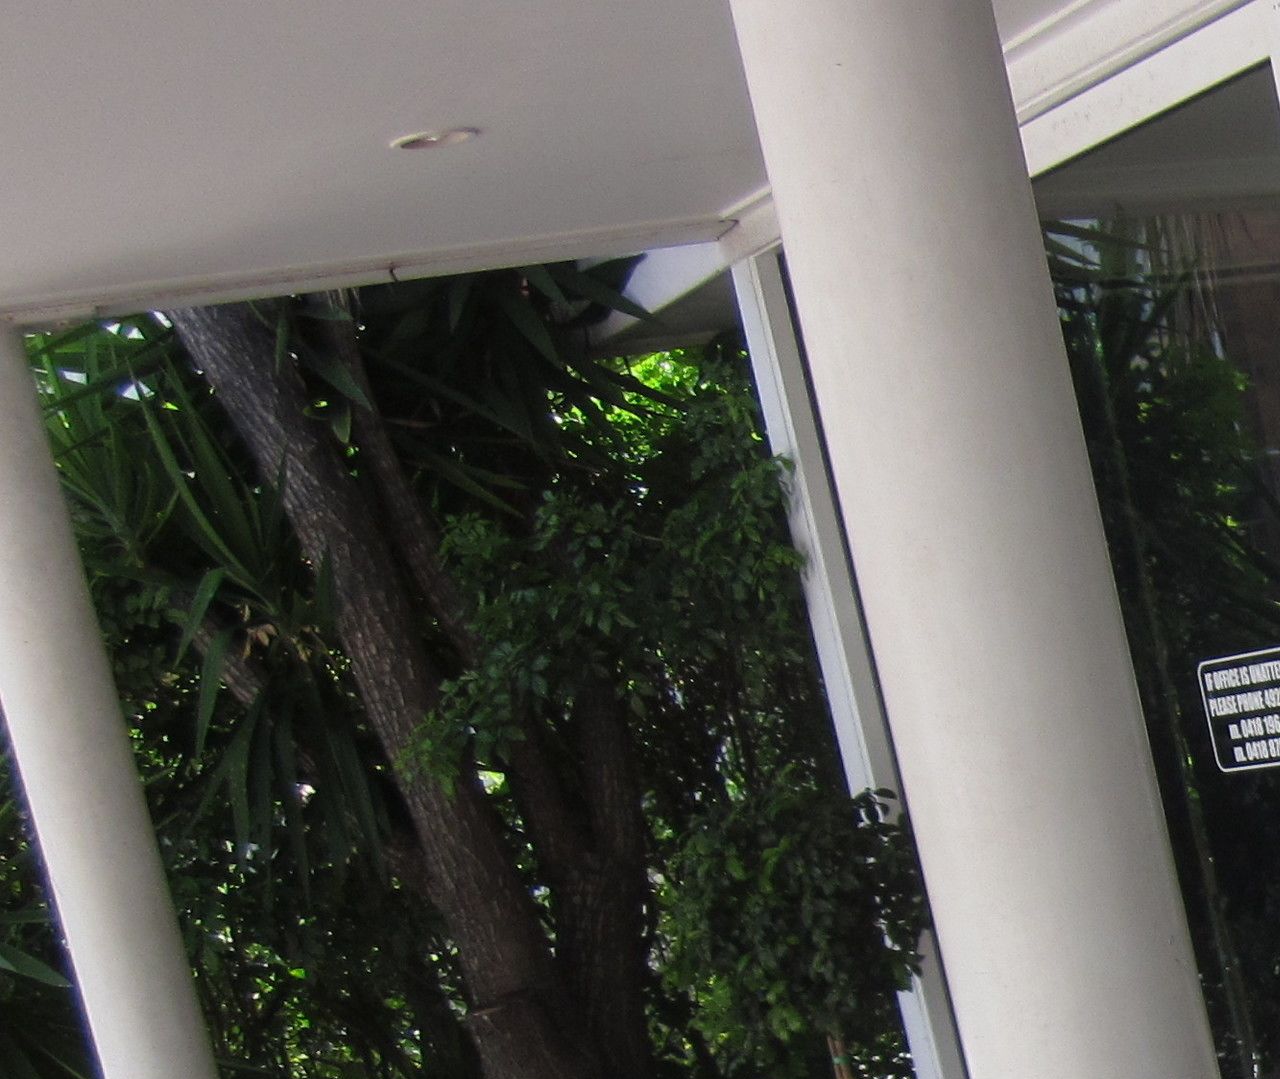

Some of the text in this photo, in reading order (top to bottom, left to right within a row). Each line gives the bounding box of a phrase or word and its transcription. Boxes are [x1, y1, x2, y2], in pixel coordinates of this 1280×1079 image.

[1204, 672, 1214, 692] IF
[1212, 667, 1241, 691] OFFICE
[1239, 666, 1251, 686] IS
[1208, 694, 1239, 717] PLEASE
[1236, 690, 1265, 713] PHONE
